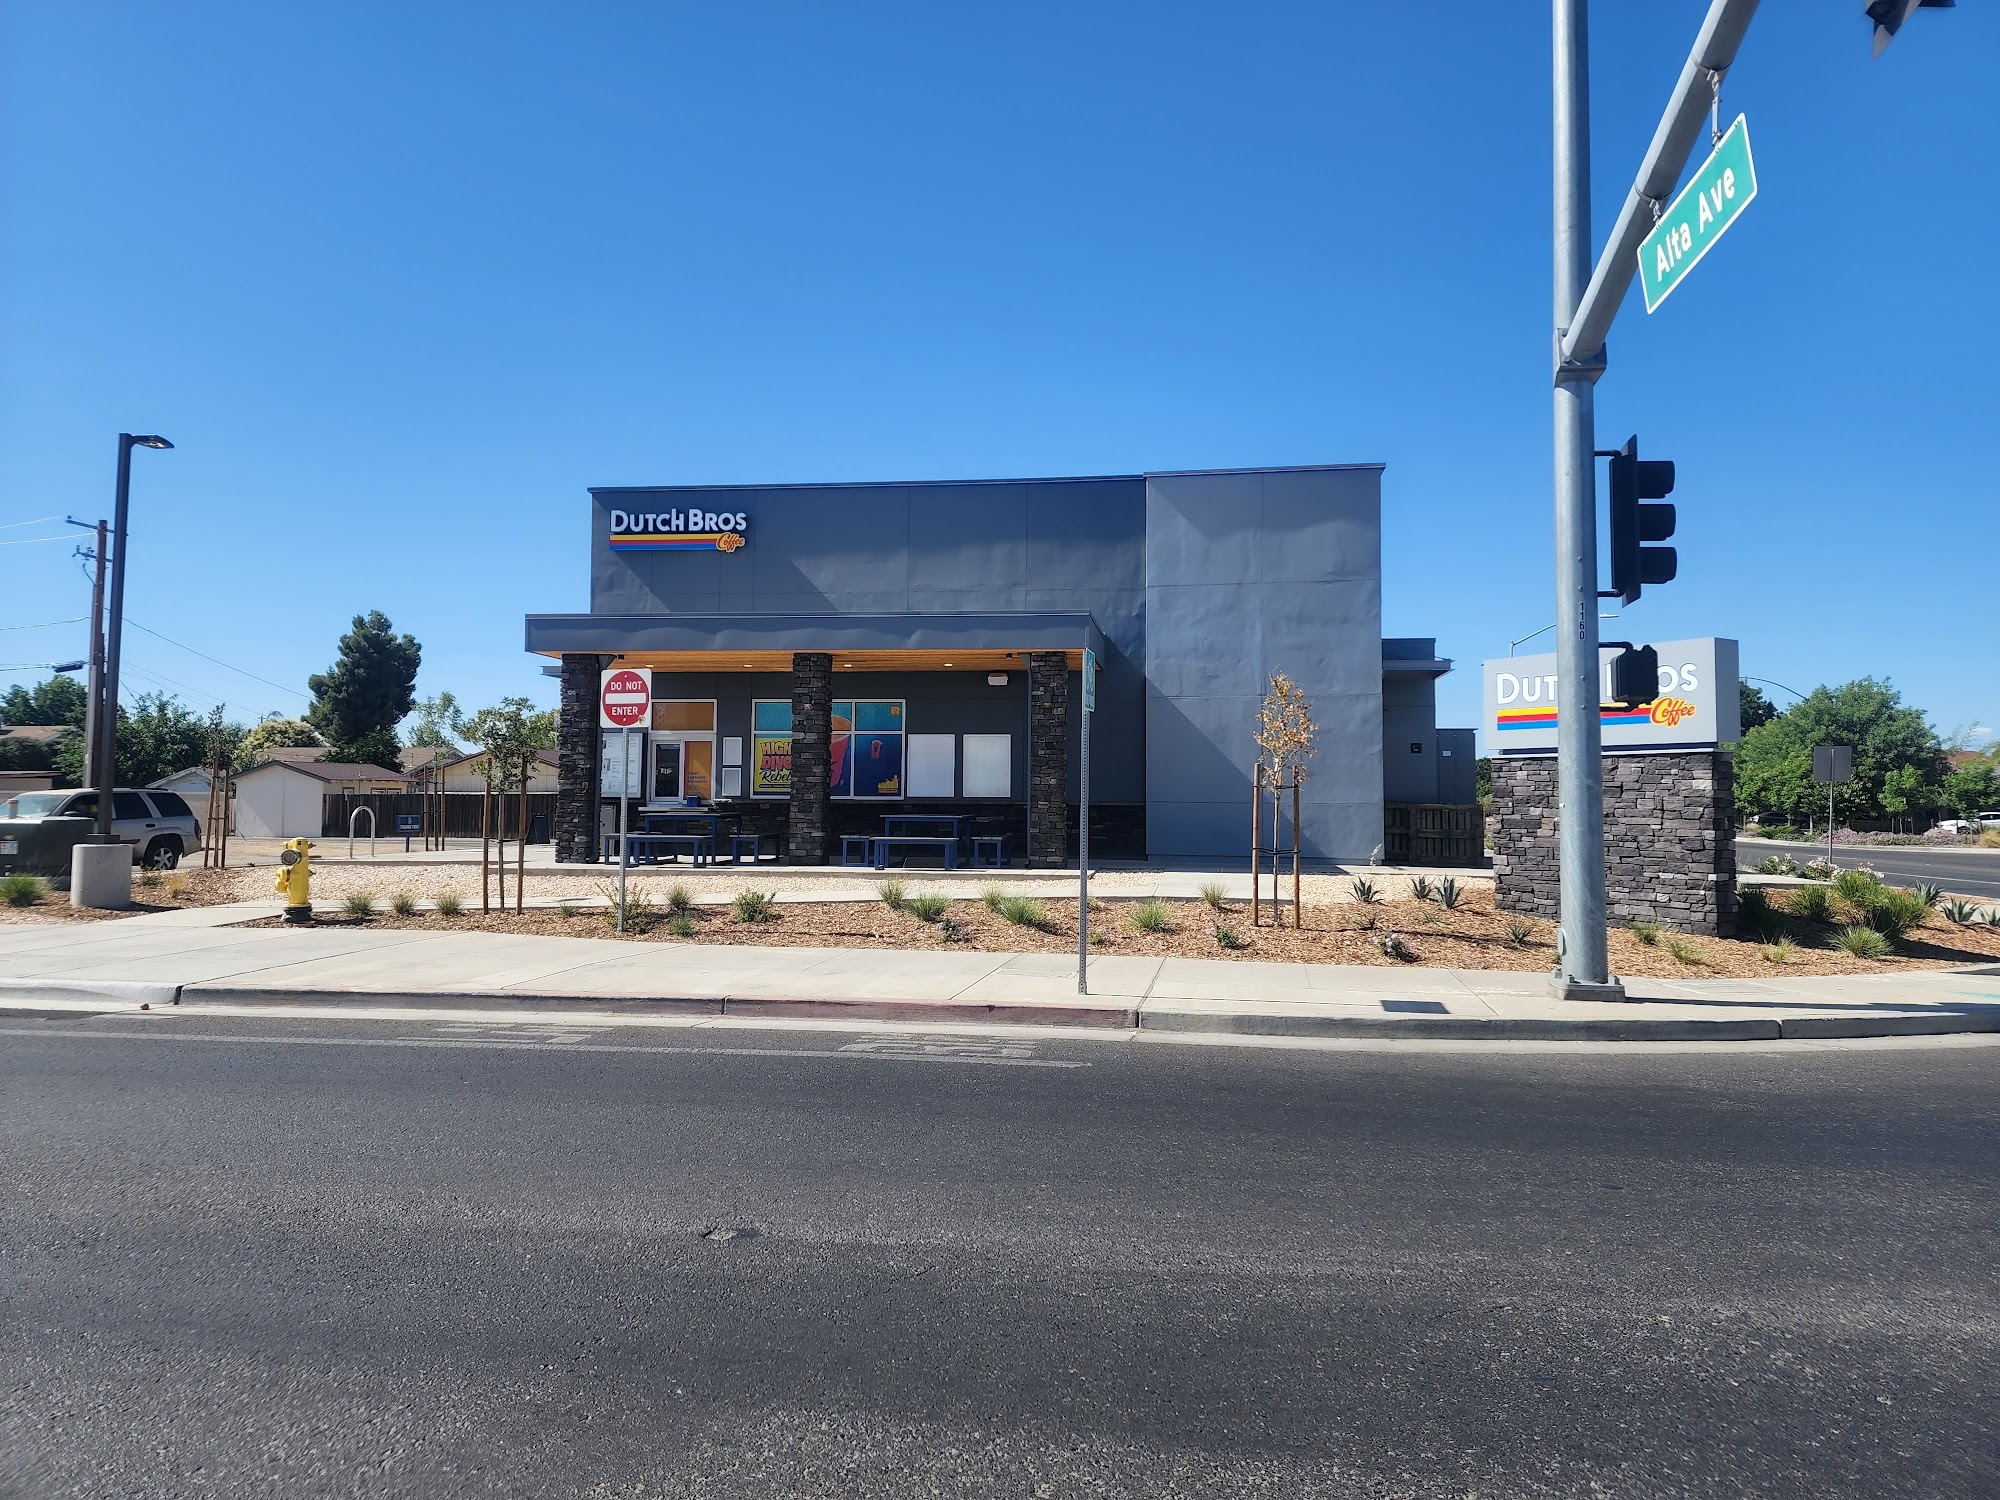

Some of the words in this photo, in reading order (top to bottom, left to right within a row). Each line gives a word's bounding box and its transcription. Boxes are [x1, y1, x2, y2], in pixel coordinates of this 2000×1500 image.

[1657, 221, 1692, 283] Alta
[1699, 167, 1736, 235] Ave
[610, 508, 684, 532] DUTCH
[688, 508, 747, 532] BROS
[716, 532, 745, 552] Coffee
[610, 681, 622, 691] DO
[626, 681, 642, 691] NOT
[1497, 672, 1558, 704] DUT
[611, 706, 639, 716] ENTER
[1651, 697, 1696, 727] Coffee
[760, 741, 792, 755] HIGH
[759, 770, 792, 784] Rebel
